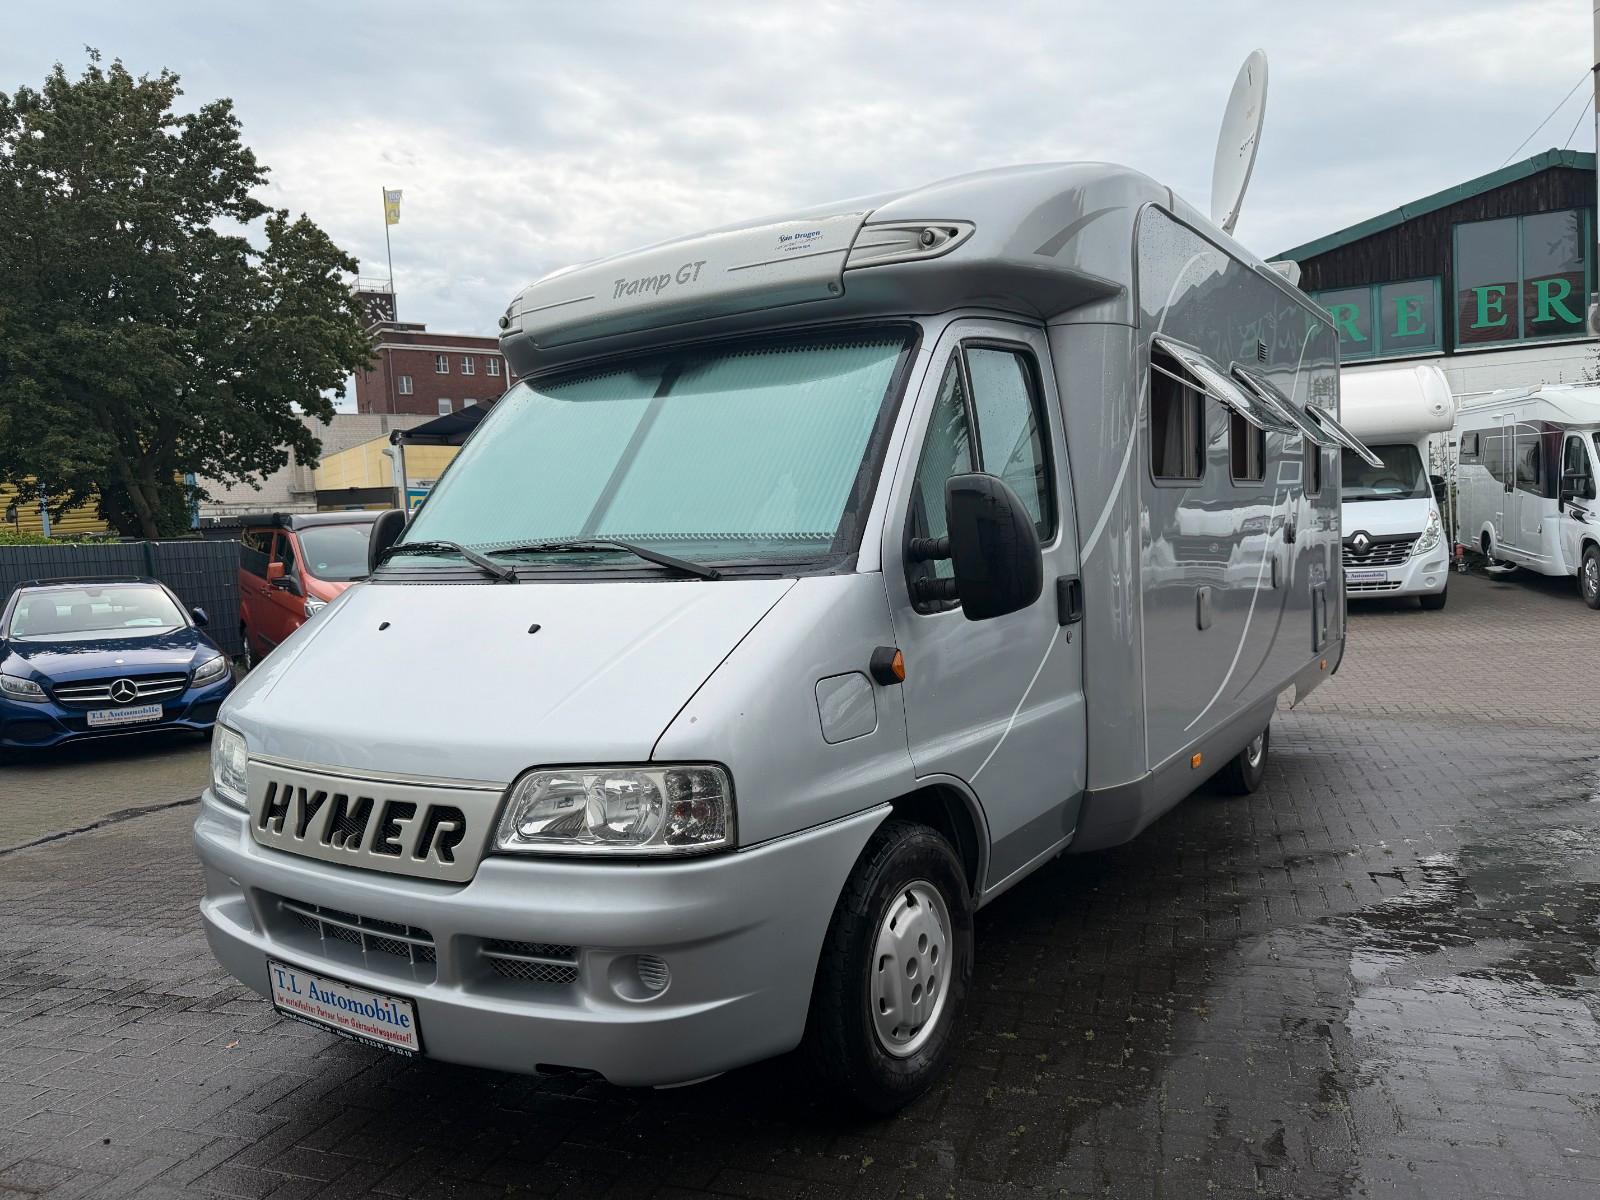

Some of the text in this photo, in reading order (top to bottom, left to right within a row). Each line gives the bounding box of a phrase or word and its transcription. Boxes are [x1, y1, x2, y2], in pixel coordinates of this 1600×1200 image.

[613, 260, 707, 299] Tramp GT
[108, 705, 160, 718] Automobile
[257, 782, 467, 864] HYMER
[308, 980, 410, 1028] Automobile
